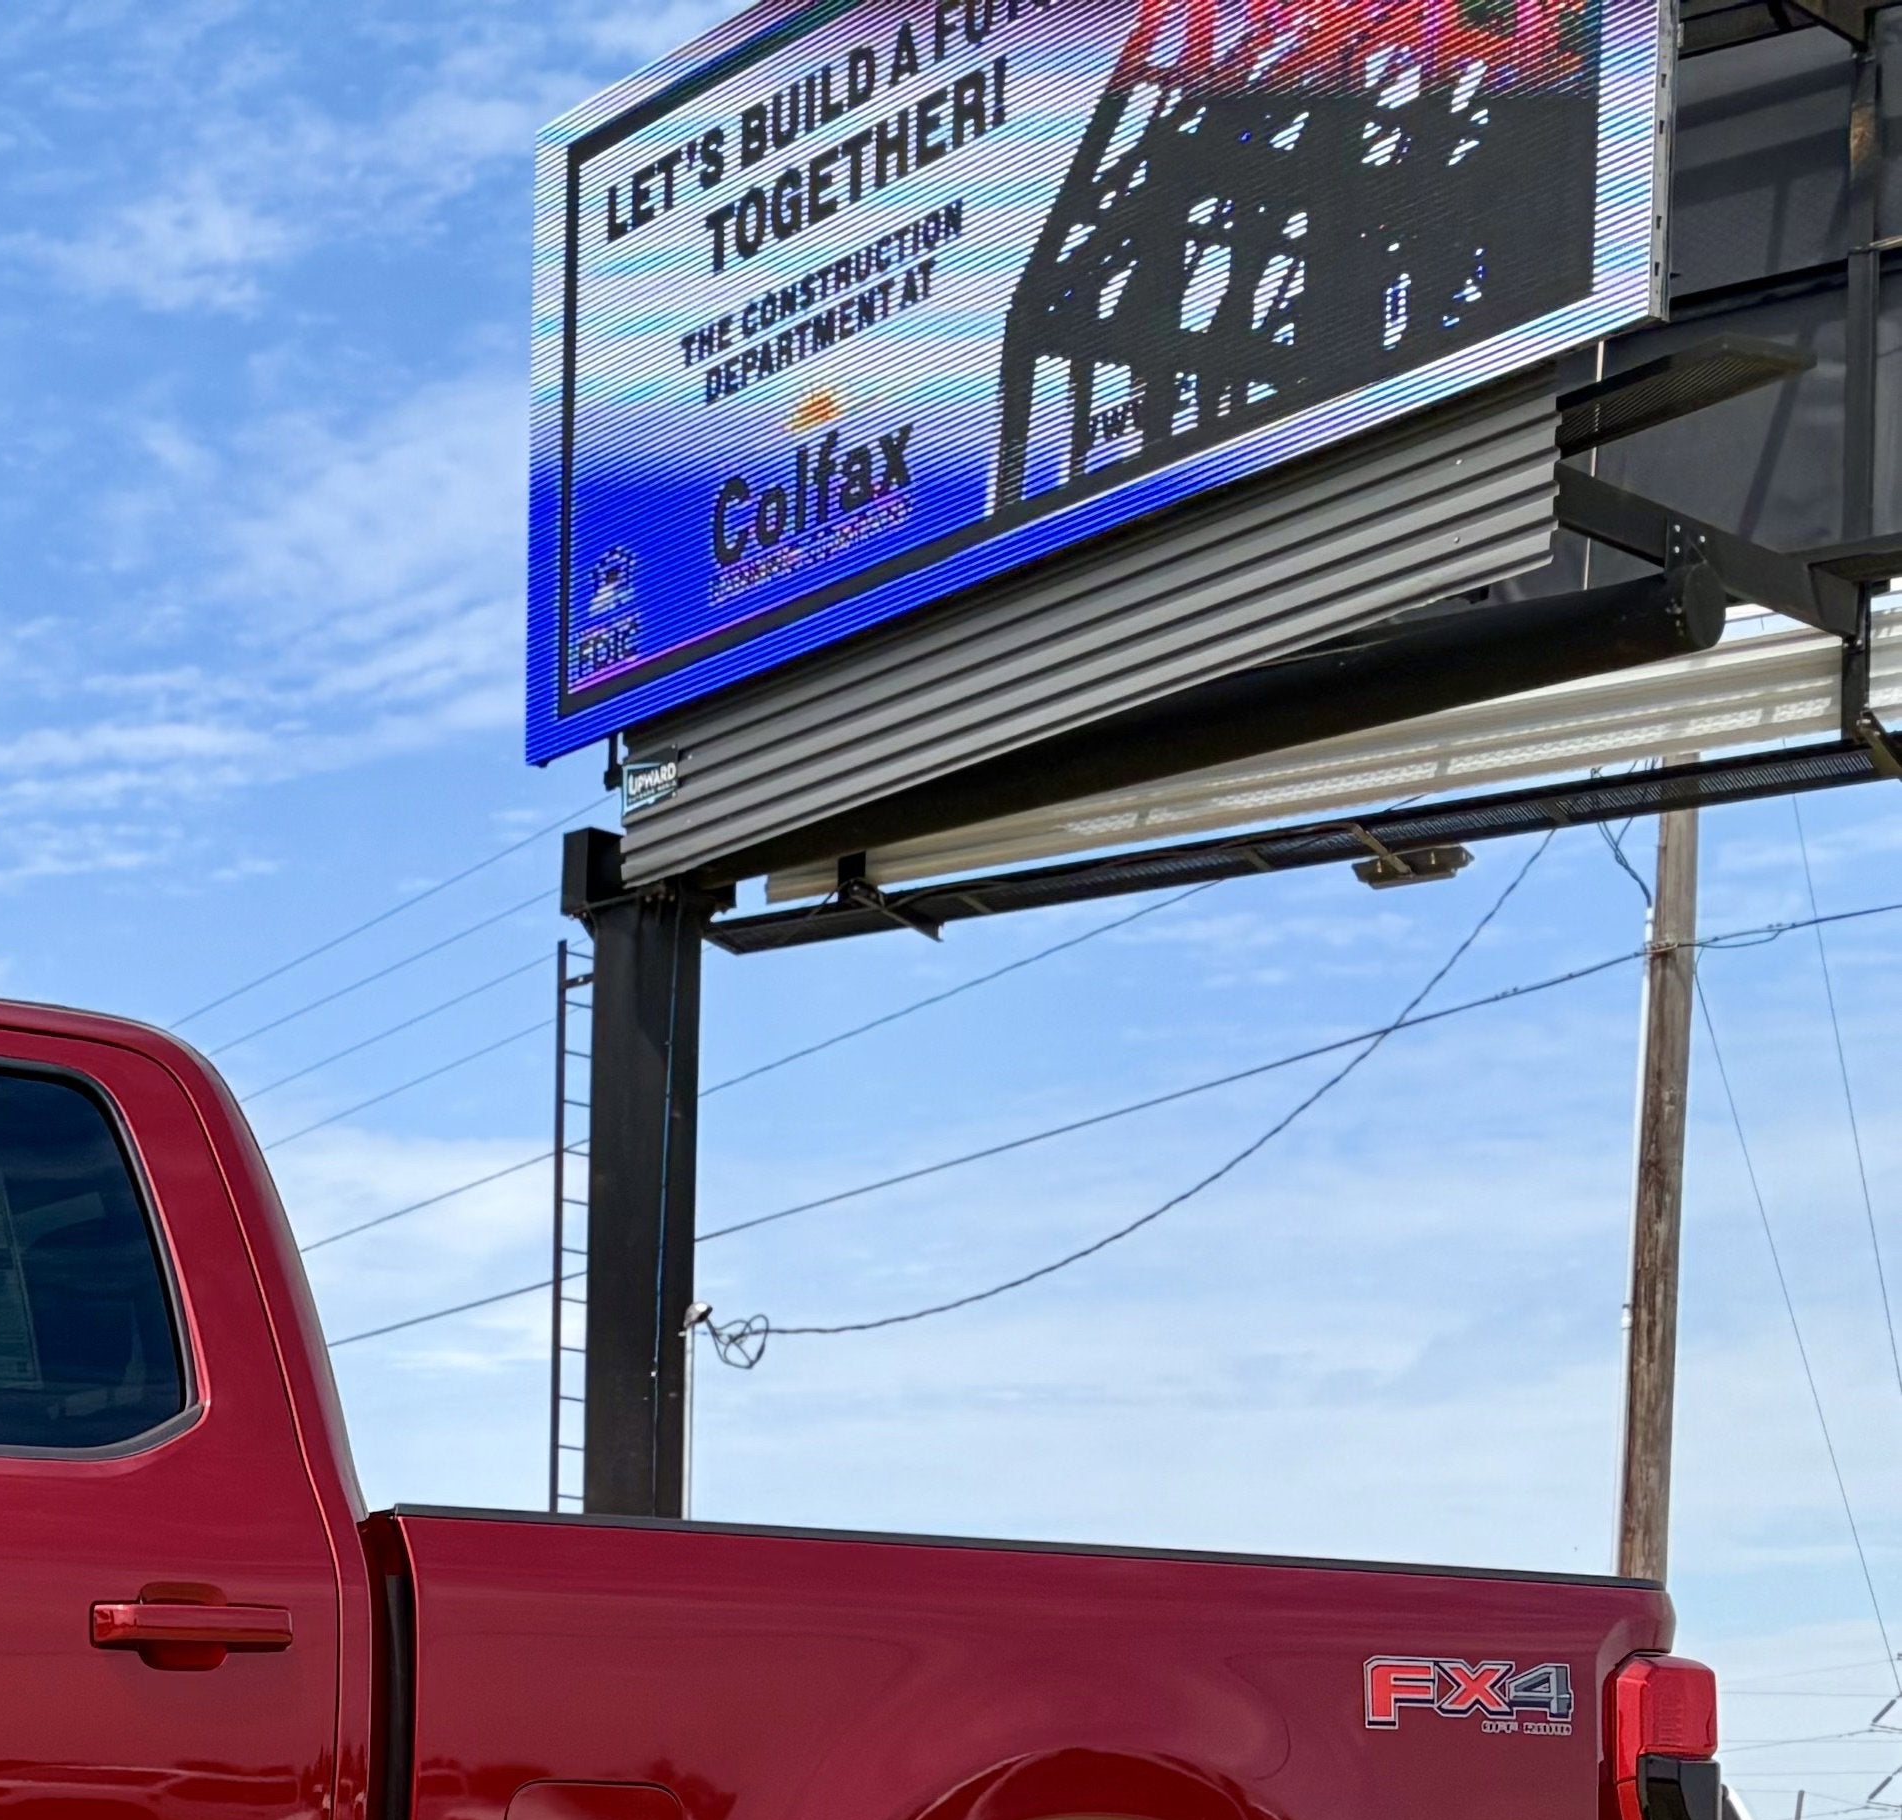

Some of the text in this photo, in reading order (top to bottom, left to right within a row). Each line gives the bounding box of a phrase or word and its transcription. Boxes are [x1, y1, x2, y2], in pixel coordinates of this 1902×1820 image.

[607, 125, 725, 242] LET'S
[741, 47, 876, 170] BUILD
[890, 20, 920, 86] A
[705, 55, 1008, 274] TOGETHER!
[680, 199, 963, 369] THE CONSTRUCTION
[705, 257, 937, 406] DEPARTMENT AT
[712, 423, 914, 566] Colfax
[628, 761, 677, 796] UPWARD
[1363, 1655, 1574, 1729] FX4
